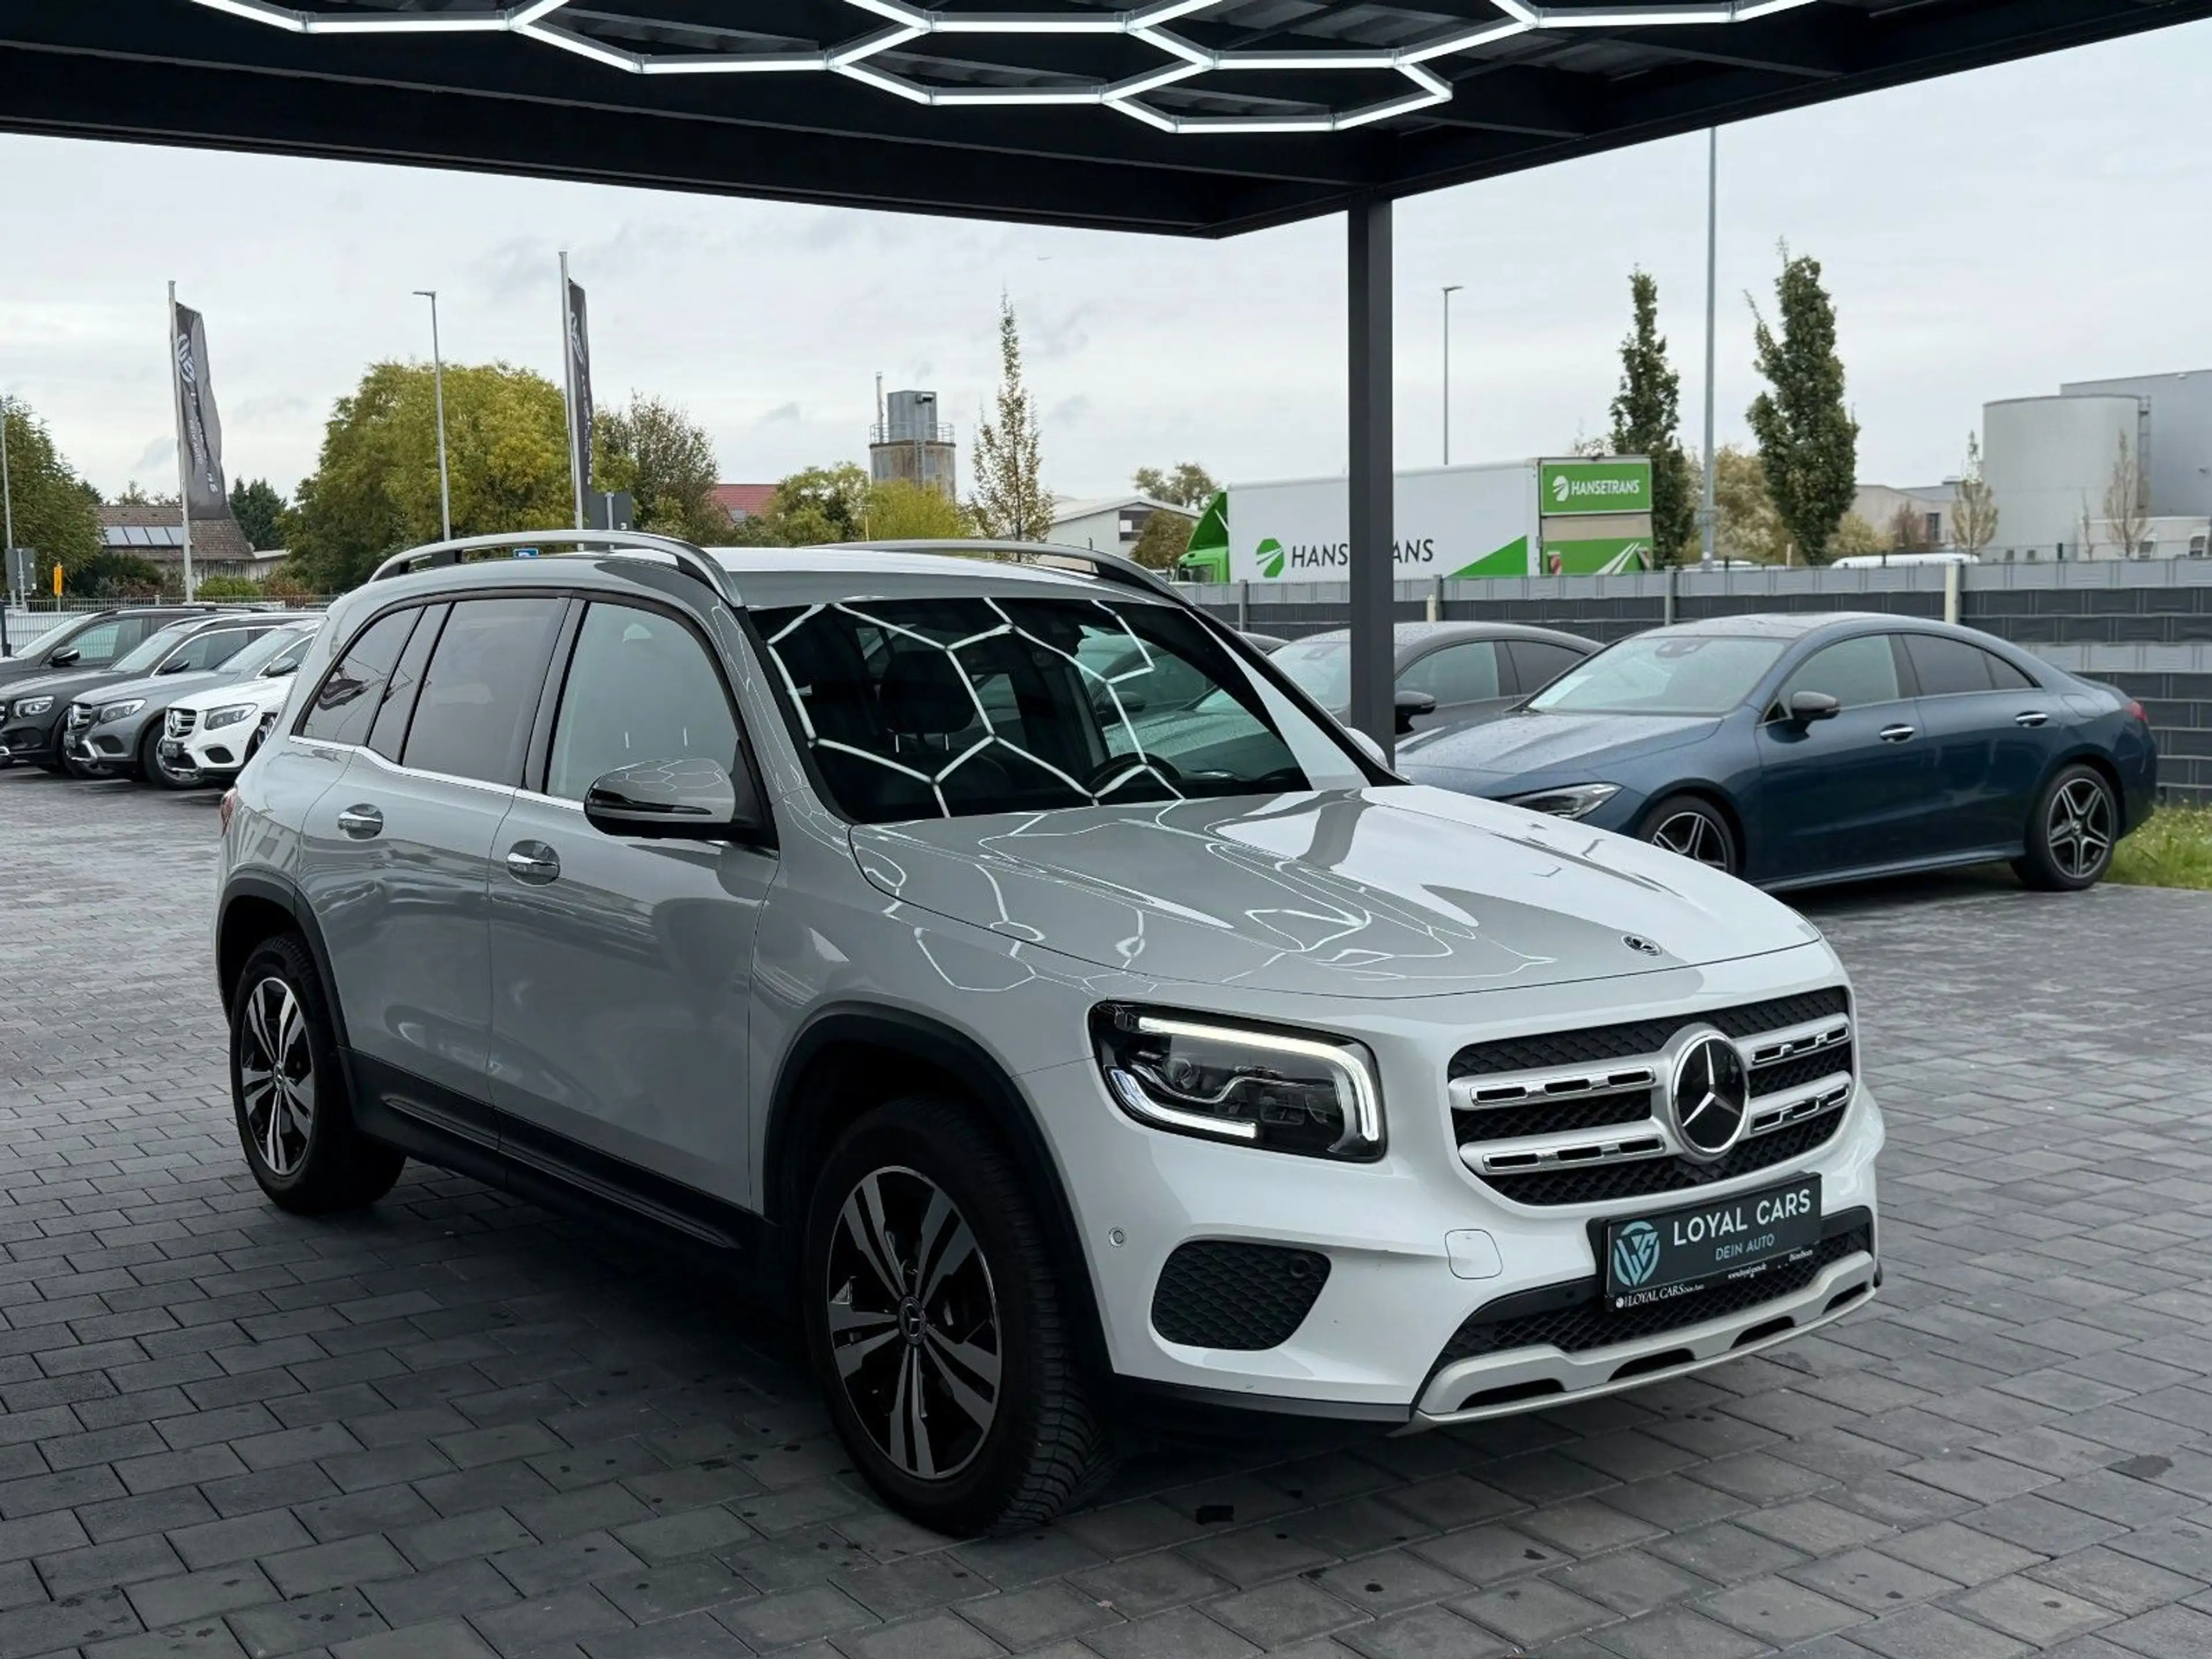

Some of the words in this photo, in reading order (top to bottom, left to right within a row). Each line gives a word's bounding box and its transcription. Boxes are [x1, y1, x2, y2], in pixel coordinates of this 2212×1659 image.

[1571, 479, 1641, 495] HANSETRANS
[1291, 539, 1433, 568] HANSANS
[1674, 1207, 1748, 1246] LOYAL
[1756, 1188, 1810, 1225] CARS
[1715, 1243, 1743, 1261] DEIN
[1745, 1233, 1775, 1252] AUTO
[1627, 1290, 1660, 1307] LOYAL
[1660, 1283, 1684, 1300] CARS
